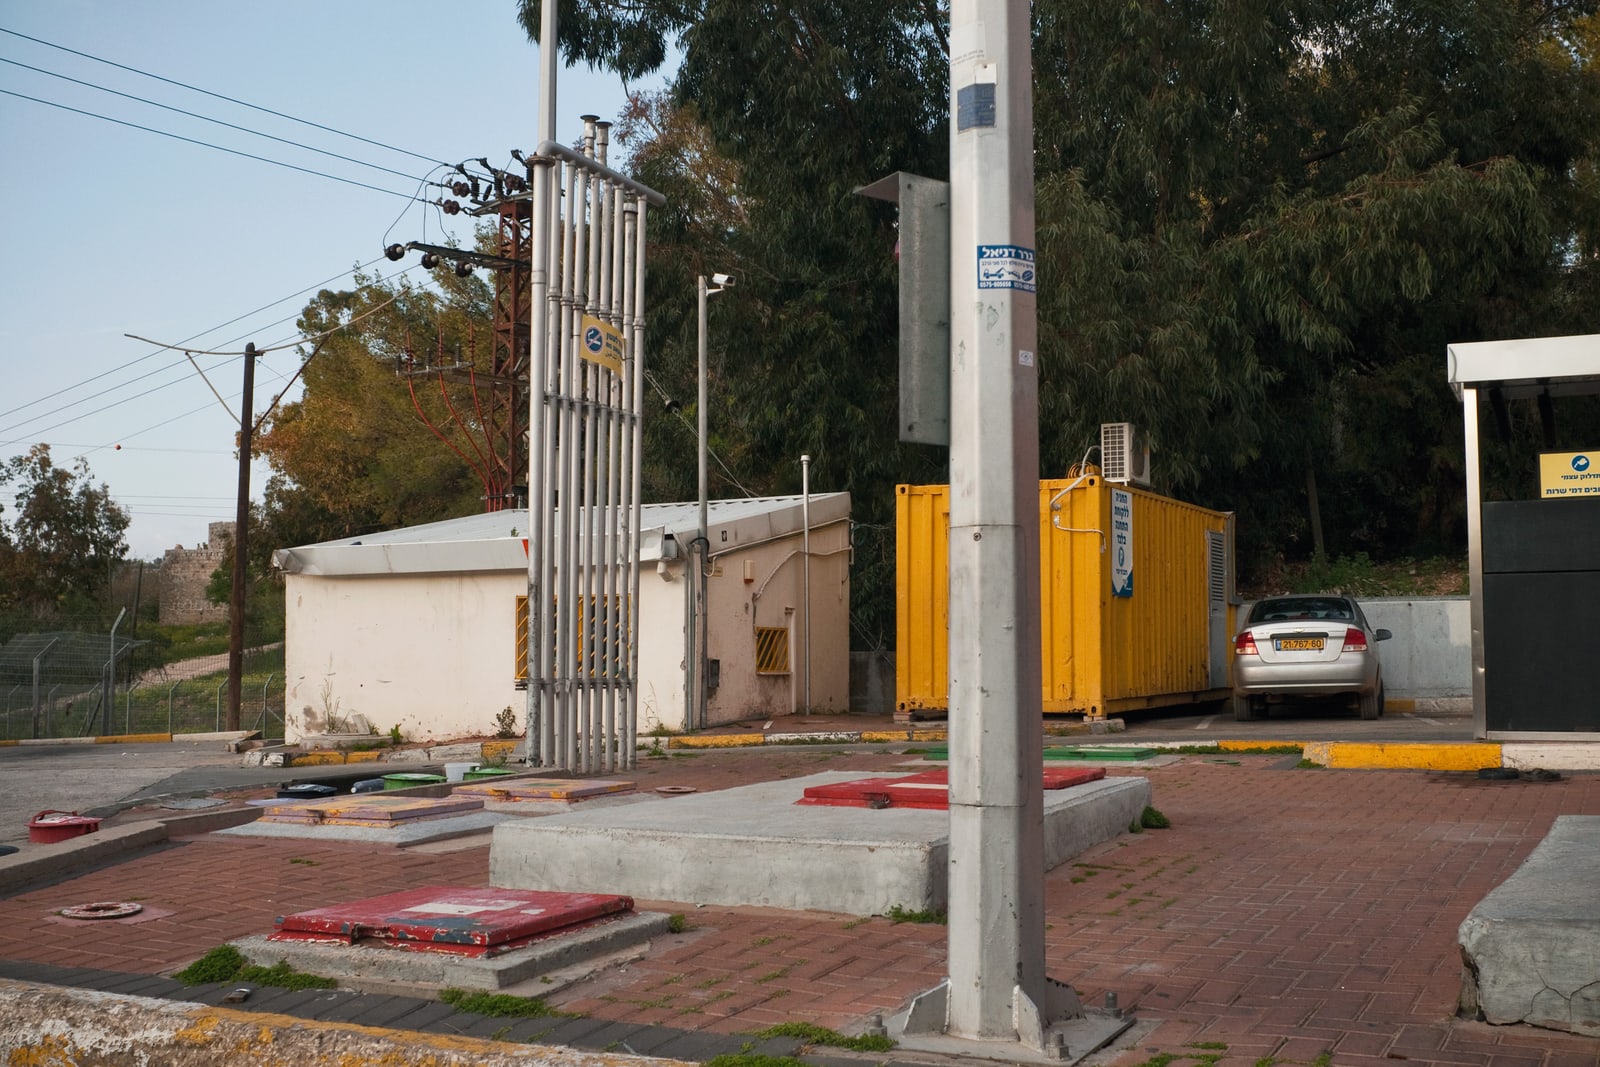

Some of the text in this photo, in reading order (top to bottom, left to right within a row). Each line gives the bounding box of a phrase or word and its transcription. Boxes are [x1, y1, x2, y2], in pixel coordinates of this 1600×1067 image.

[982, 246, 1033, 261] גרר דניאל
[1117, 533, 1127, 545] בלבד
